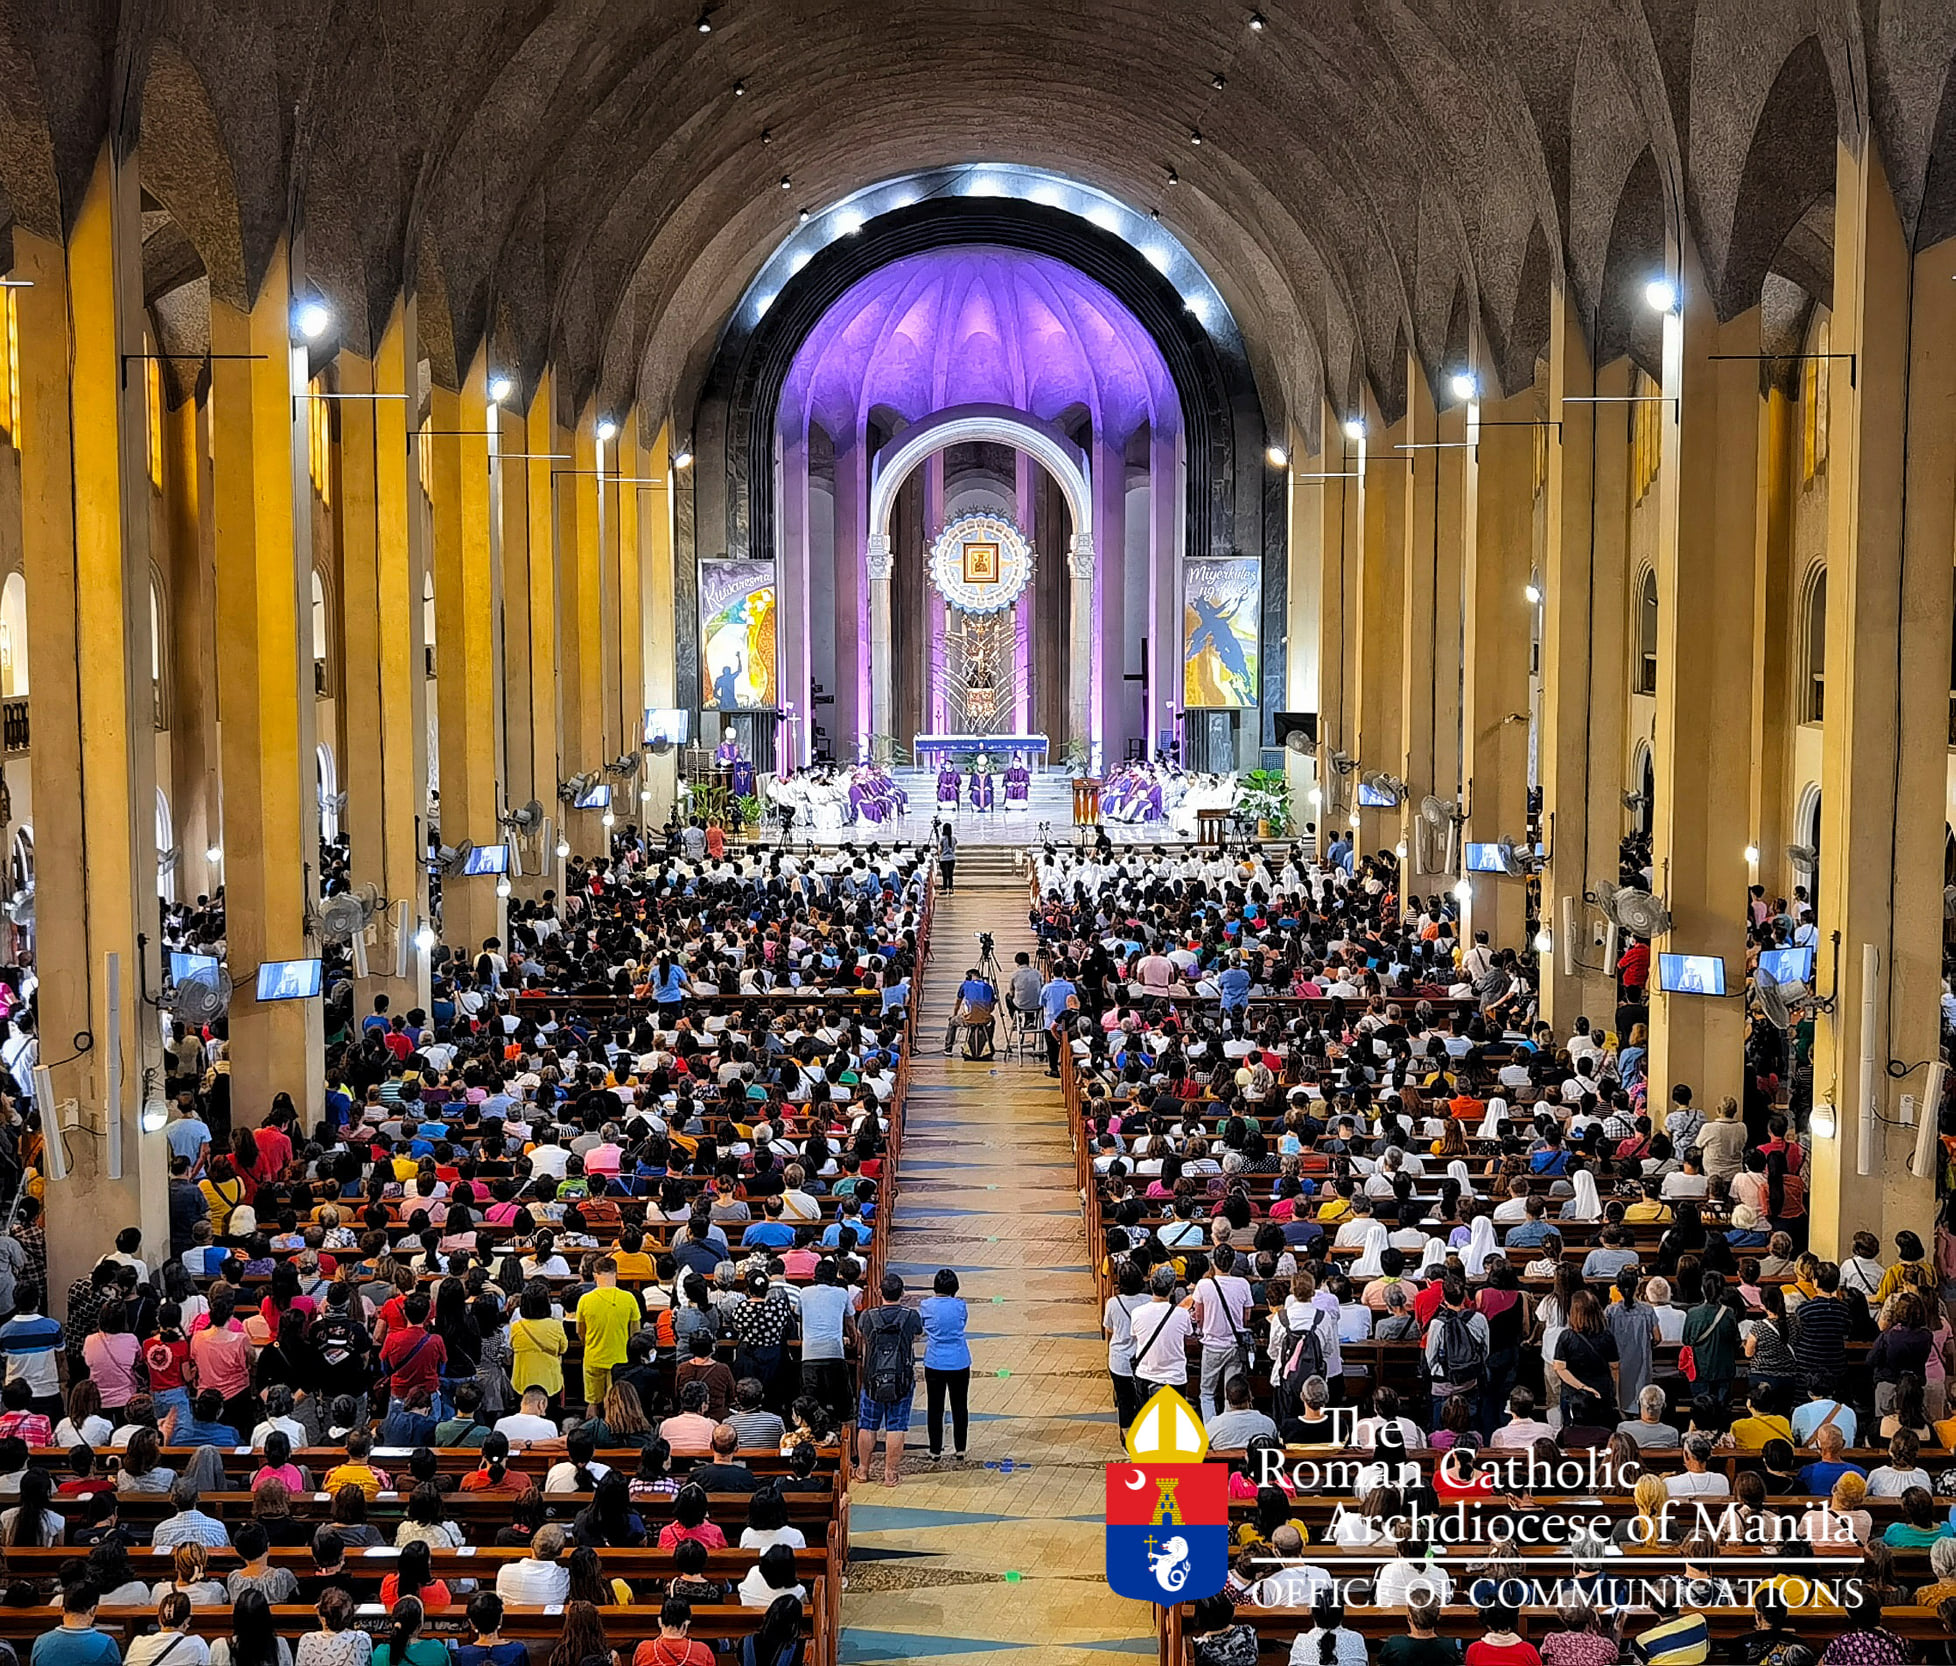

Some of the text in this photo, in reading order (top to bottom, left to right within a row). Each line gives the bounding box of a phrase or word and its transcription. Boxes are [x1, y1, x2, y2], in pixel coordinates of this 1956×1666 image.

[1190, 565, 1256, 584] Miyerkules
[704, 574, 771, 611] Kuwaresma
[1198, 586, 1215, 601] ng
